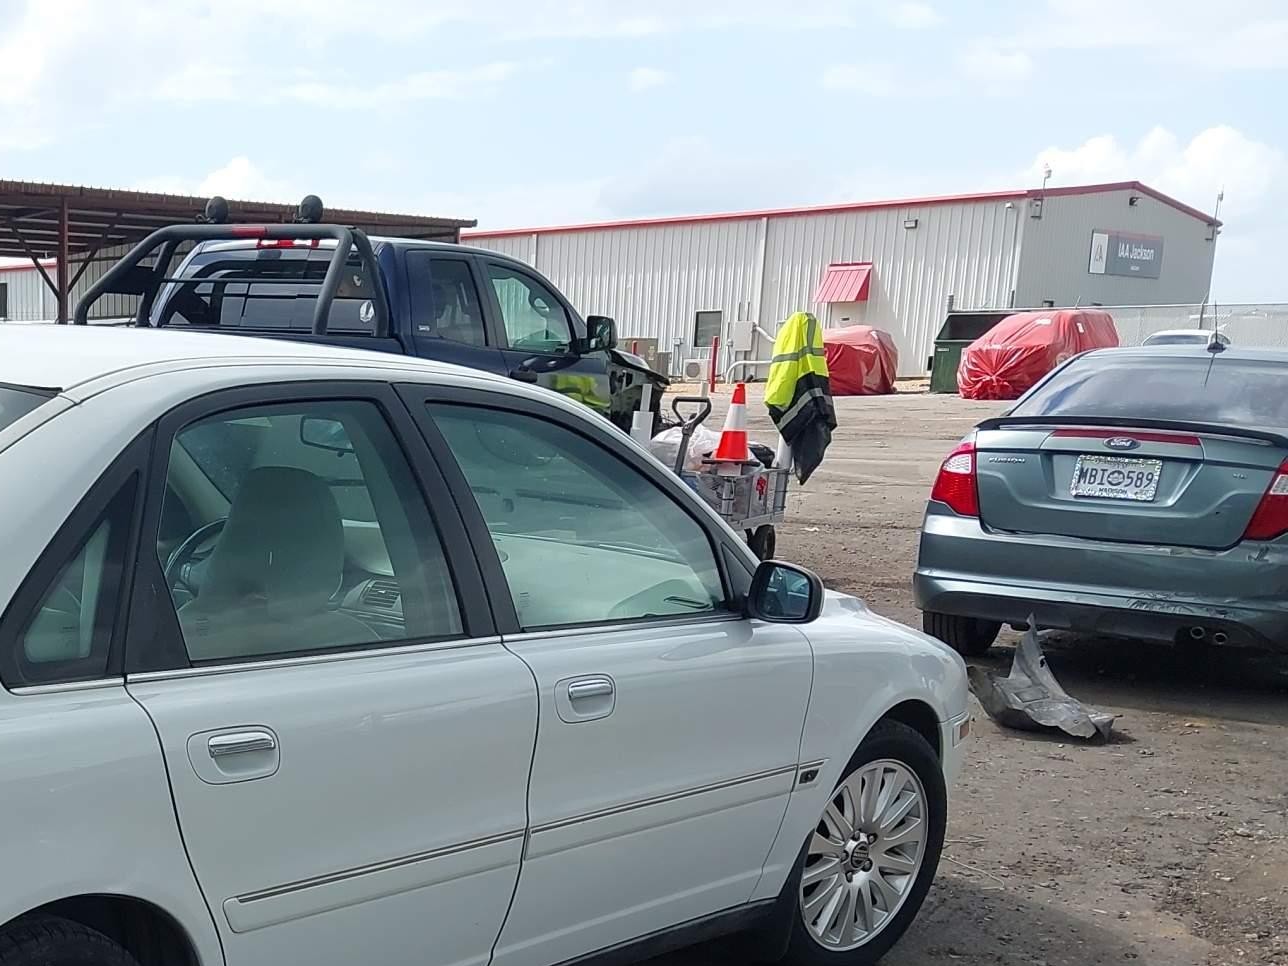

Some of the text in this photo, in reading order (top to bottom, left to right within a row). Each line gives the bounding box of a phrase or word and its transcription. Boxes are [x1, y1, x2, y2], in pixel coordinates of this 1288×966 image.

[1118, 242, 1130, 258] IAA
[1130, 243, 1154, 261] Jackson
[1078, 467, 1154, 489] MBI 589
